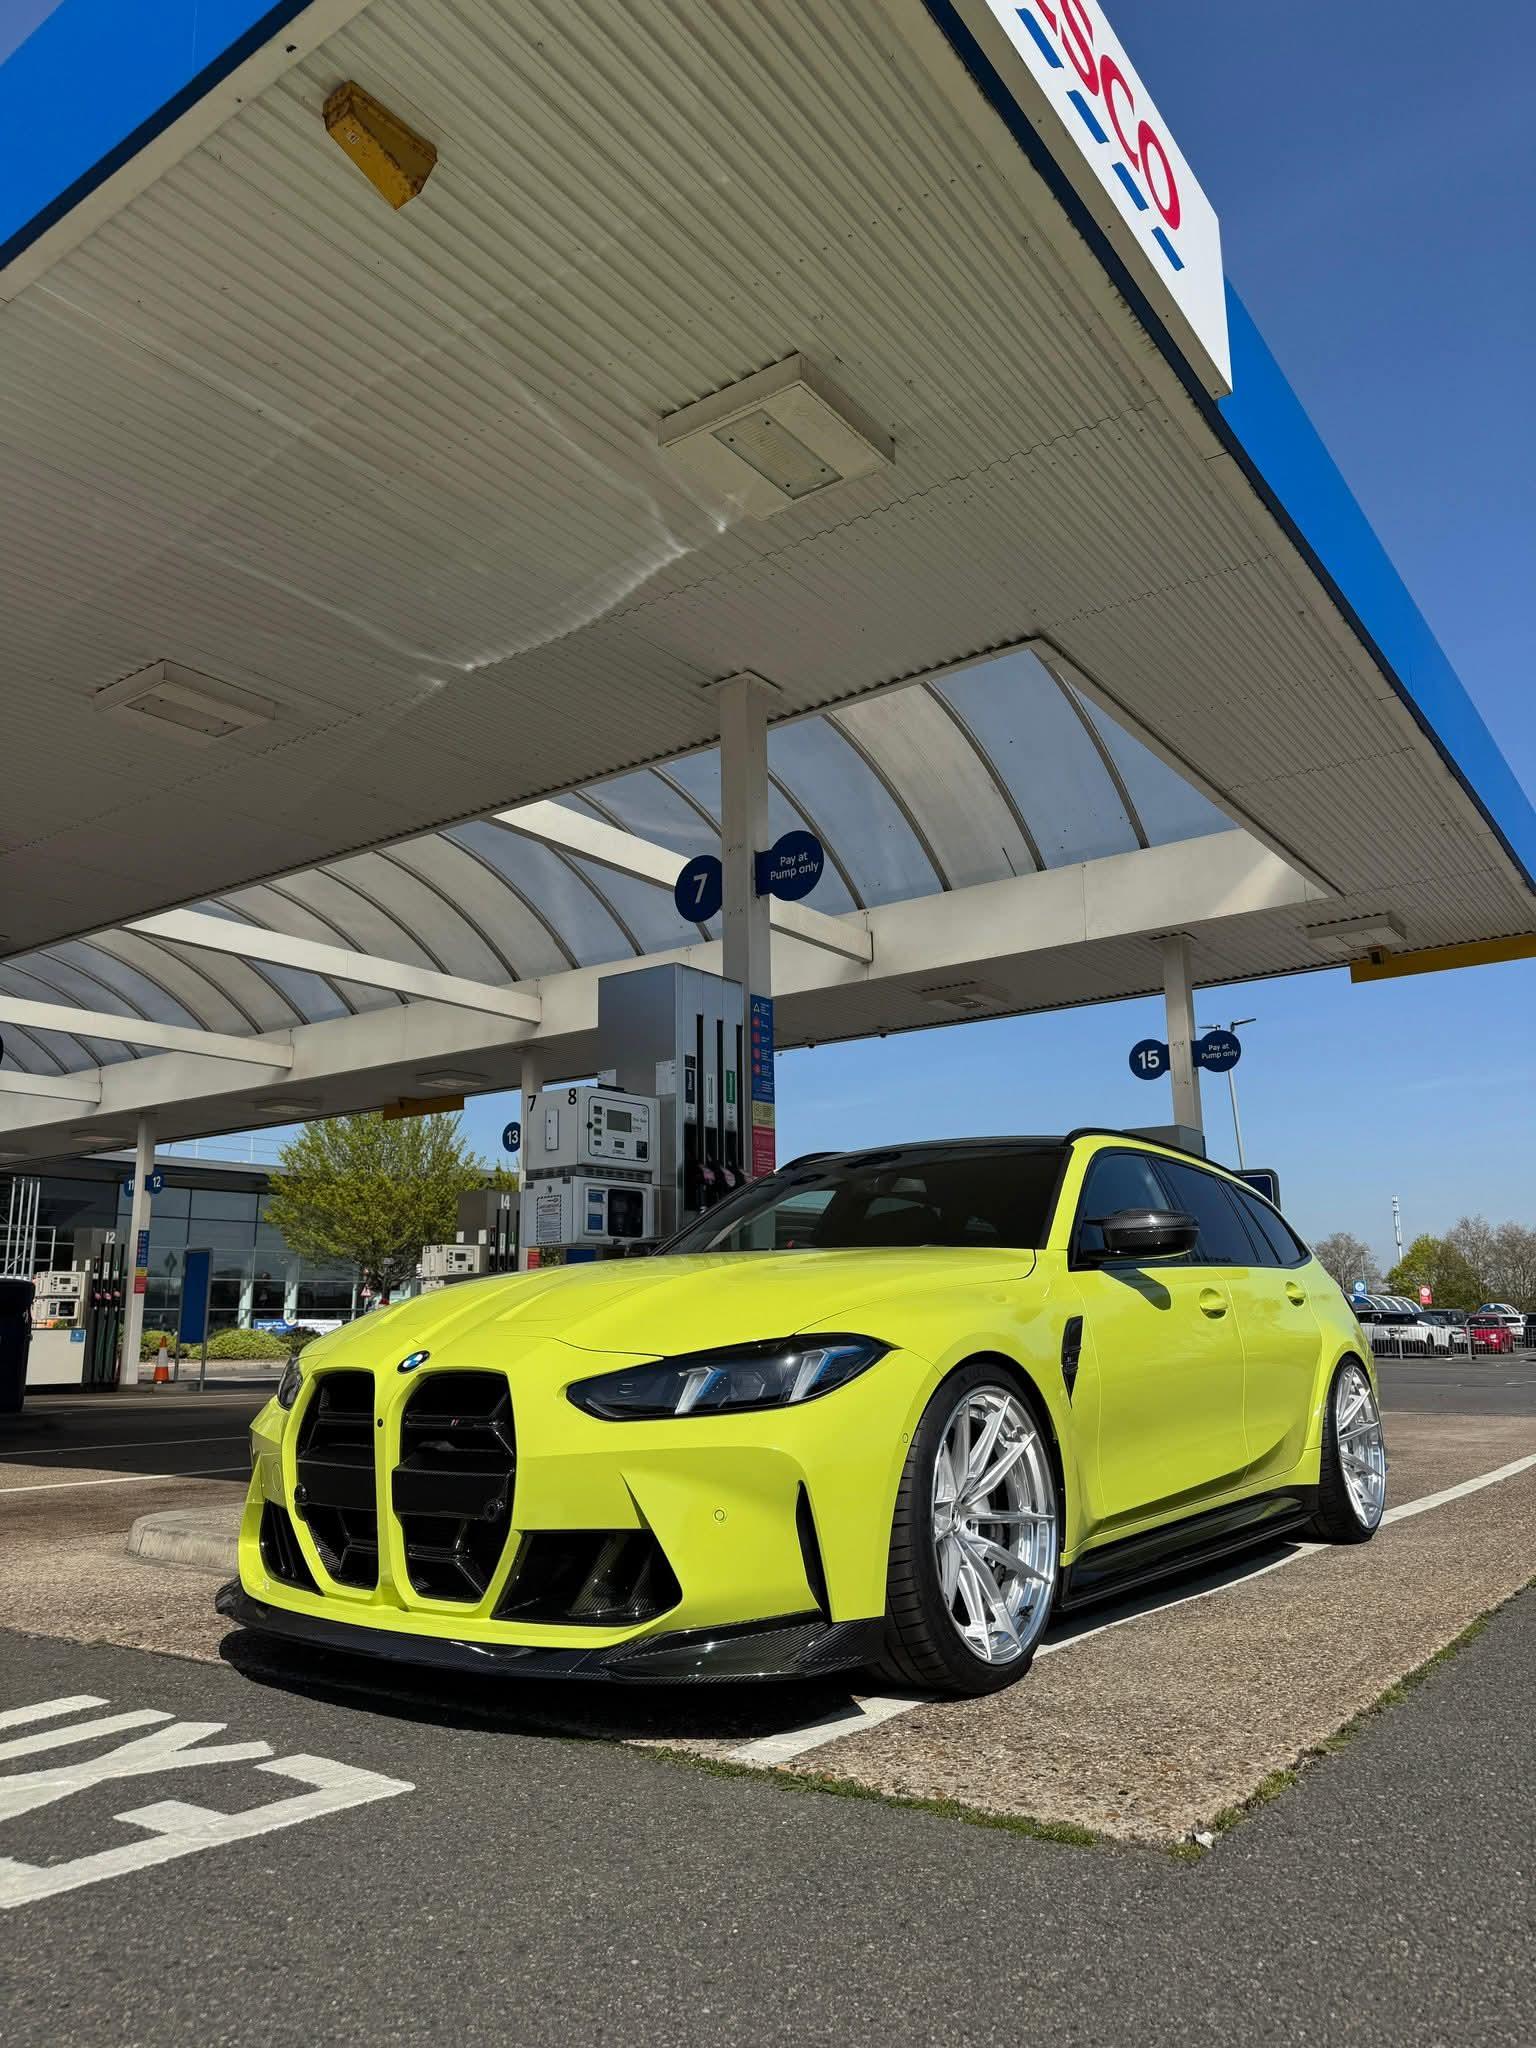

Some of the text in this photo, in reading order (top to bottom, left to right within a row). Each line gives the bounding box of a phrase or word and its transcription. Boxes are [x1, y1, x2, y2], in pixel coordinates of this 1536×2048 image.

[1035, 0, 1181, 231] SCO
[780, 852, 809, 867] Pay at
[770, 861, 820, 881] Pump only
[693, 872, 708, 905] 7
[1201, 1049, 1238, 1060] Pump only
[1208, 1044, 1221, 1052] Pay
[1138, 1050, 1160, 1070] 15
[527, 1094, 537, 1112] 7
[568, 1087, 577, 1105] 8
[507, 1129, 519, 1145] 13
[153, 1176, 161, 1188] 12
[501, 1194, 510, 1210] 14
[105, 1231, 116, 1244] 12
